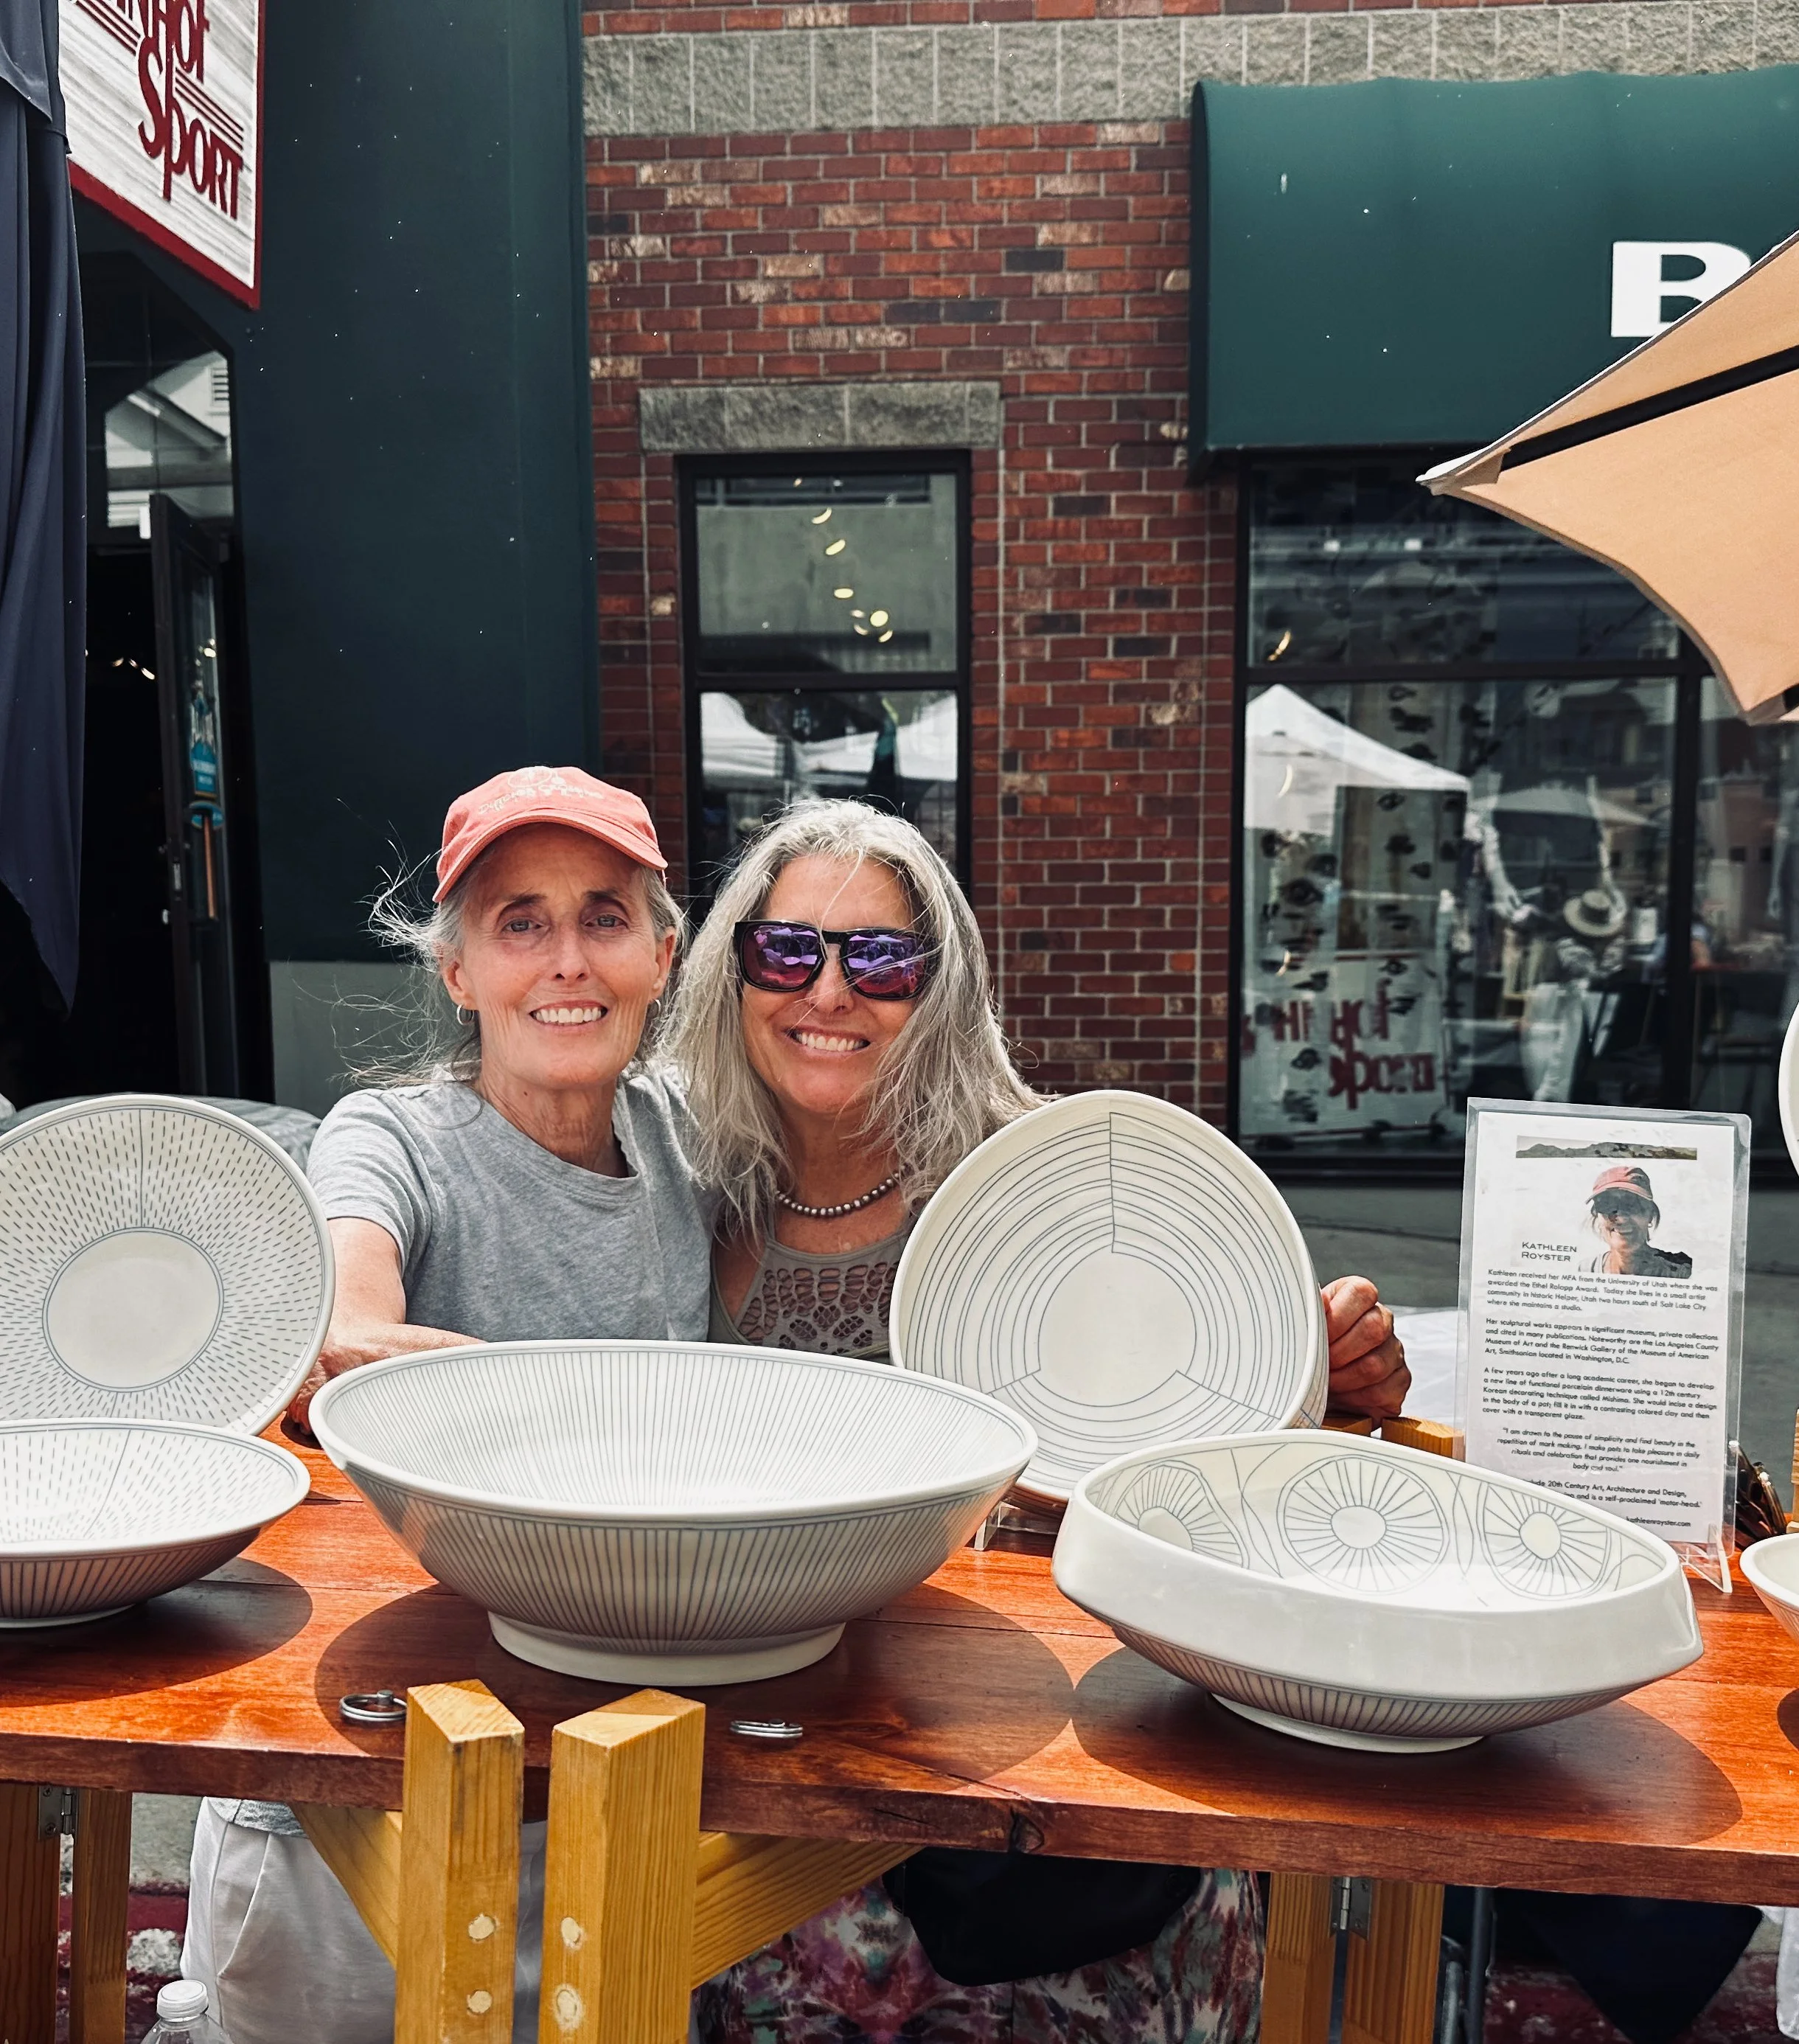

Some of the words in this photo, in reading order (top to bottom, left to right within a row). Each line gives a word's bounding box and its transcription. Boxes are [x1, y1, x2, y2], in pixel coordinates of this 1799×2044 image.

[1523, 1242, 1577, 1253] KATHLEEN
[1522, 1251, 1571, 1262] ROYSTER
[1488, 1269, 1517, 1277] Kathleen
[1608, 1278, 1640, 1287] University
[1576, 1285, 1599, 1293] Award.
[1604, 1287, 1624, 1296] Today
[1487, 1290, 1521, 1299] community
[1531, 1292, 1553, 1300] historic
[1693, 1304, 1706, 1312] City
[1522, 1301, 1553, 1310] maintains
[1592, 1326, 1626, 1334] significant
[1485, 1338, 1512, 1346] Museum
[1590, 1345, 1616, 1355] Gallery
[1588, 1335, 1627, 1346] Noteworthy
[1667, 1341, 1694, 1349] Angeles
[1696, 1343, 1719, 1352] County
[1499, 1348, 1537, 1357] Smithsonian
[1539, 1351, 1564, 1360] located
[1573, 1354, 1615, 1364] Washington,
[1528, 1380, 1561, 1388] functional
[1595, 1385, 1632, 1394] dinnerware
[1634, 1388, 1652, 1397] using
[1567, 1373, 1581, 1382] long
[1583, 1375, 1615, 1383] academic
[1654, 1380, 1677, 1388] began
[1687, 1382, 1715, 1391] develop
[1483, 1386, 1508, 1394] Korean
[1509, 1388, 1545, 1399] decorating
[1546, 1392, 1579, 1400] technique
[1695, 1402, 1717, 1411] design
[1503, 1398, 1520, 1406] body
[1600, 1407, 1636, 1415] contrasting
[1665, 1410, 1679, 1418] clay
[1525, 1410, 1562, 1418] transparent
[1594, 1435, 1624, 1444] simplicity
[1654, 1439, 1677, 1447] beauty
[1557, 1442, 1582, 1450] making.
[1647, 1448, 1675, 1456] pleasure
[1684, 1451, 1700, 1459] daily
[1547, 1451, 1583, 1459] celebration
[1641, 1459, 1680, 1467] nourishment
[1573, 1462, 1590, 1471] body
[1548, 1481, 1563, 1489] 20th
[1565, 1481, 1590, 1491] Century
[1592, 1484, 1605, 1492] Art,
[1606, 1485, 1646, 1494] Architecture
[1663, 1489, 1687, 1498] Design,
[1605, 1495, 1657, 1505] self-proclaimed
